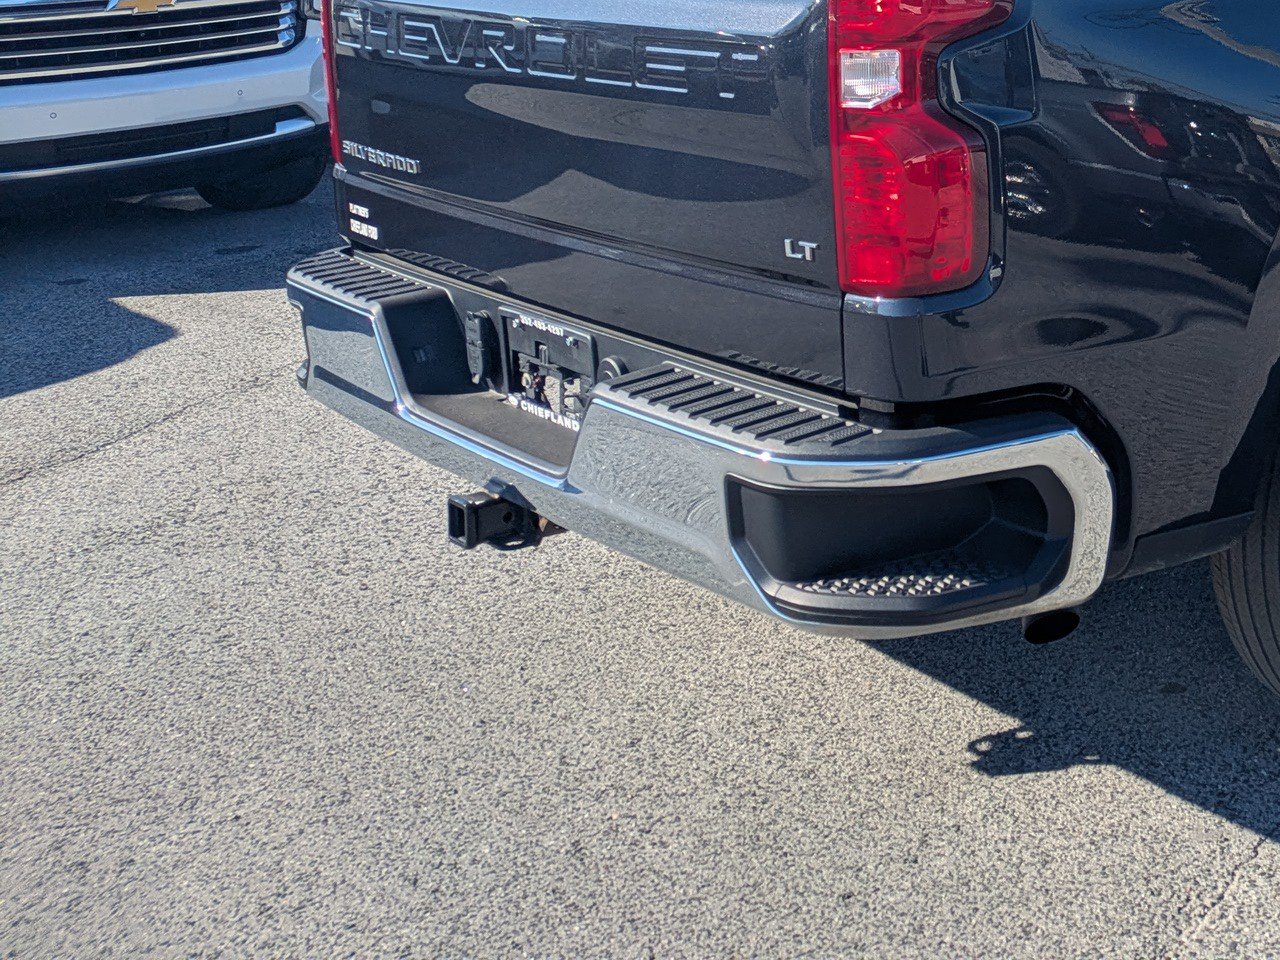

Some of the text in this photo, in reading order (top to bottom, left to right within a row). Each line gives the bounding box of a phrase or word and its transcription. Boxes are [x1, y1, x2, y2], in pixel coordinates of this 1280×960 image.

[336, 3, 770, 100] CHEVROLET
[342, 140, 421, 174] SILVERADO
[784, 238, 818, 261] LT
[520, 399, 581, 433] CHIEFLAND
